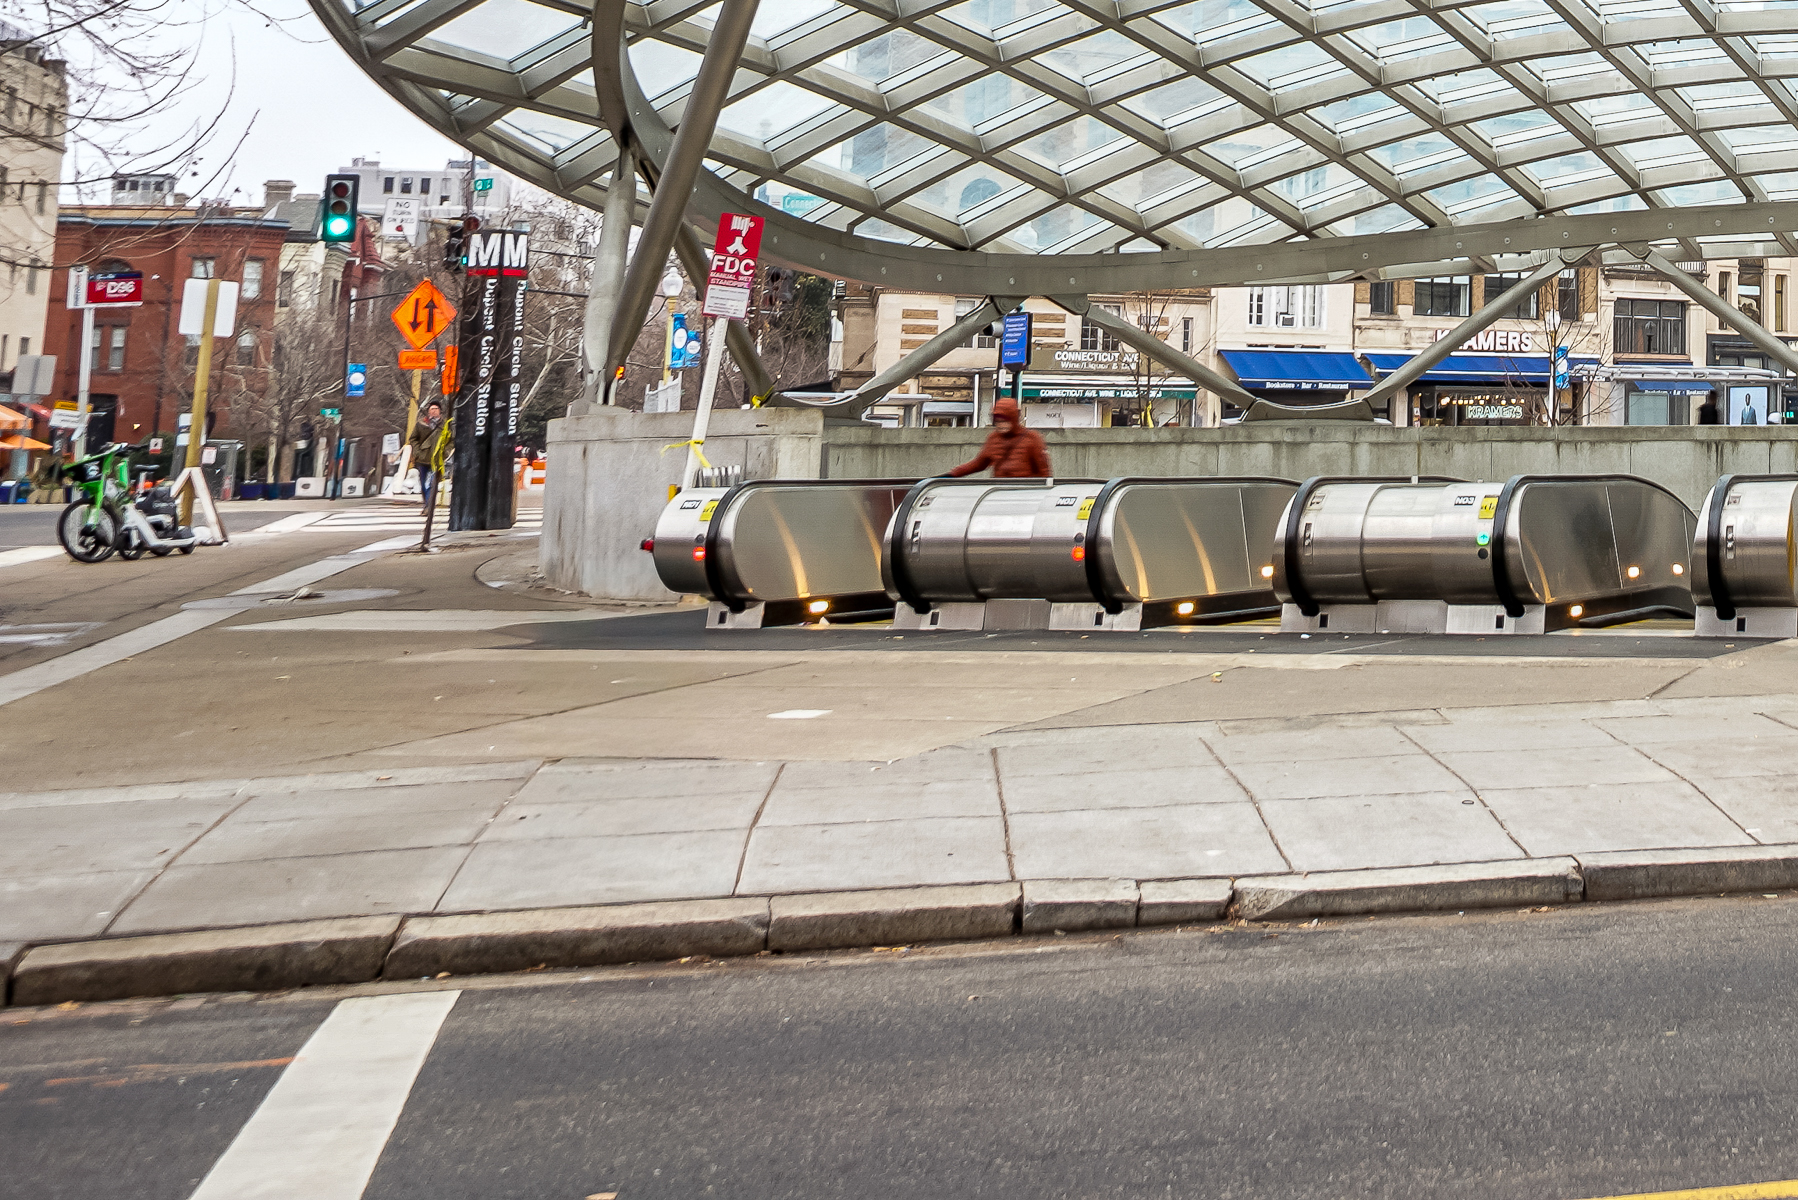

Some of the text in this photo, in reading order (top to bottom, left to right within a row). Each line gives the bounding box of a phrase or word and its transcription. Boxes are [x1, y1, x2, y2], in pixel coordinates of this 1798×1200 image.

[468, 233, 502, 267] M
[503, 233, 529, 267] M
[711, 254, 756, 276] FDC
[1434, 329, 1533, 352] KAMERS
[475, 278, 498, 436] Dupont Circle Station
[508, 280, 527, 436] Dupont Circle Station
[1054, 351, 1120, 362] CONNECTICUT
[1111, 362, 1119, 370] &
[1466, 404, 1523, 419] KRAMERS
